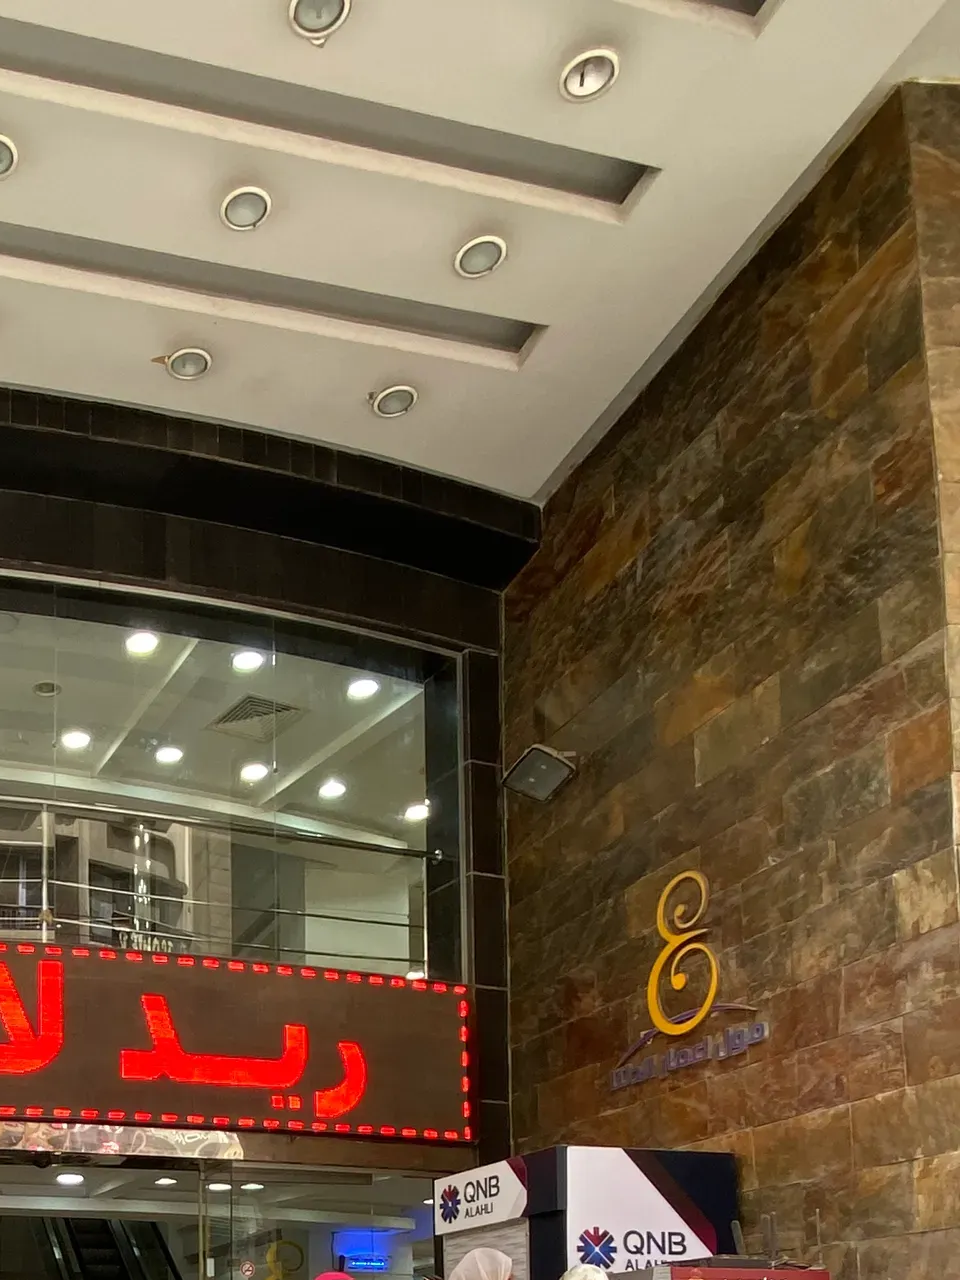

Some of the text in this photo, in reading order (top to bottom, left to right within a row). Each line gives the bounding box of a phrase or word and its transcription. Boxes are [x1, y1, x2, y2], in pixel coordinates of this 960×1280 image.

[120, 992, 368, 1118] ريد
[464, 1175, 500, 1204] QNB
[464, 1202, 494, 1218] ALAHLI
[623, 1229, 687, 1256] QNB
